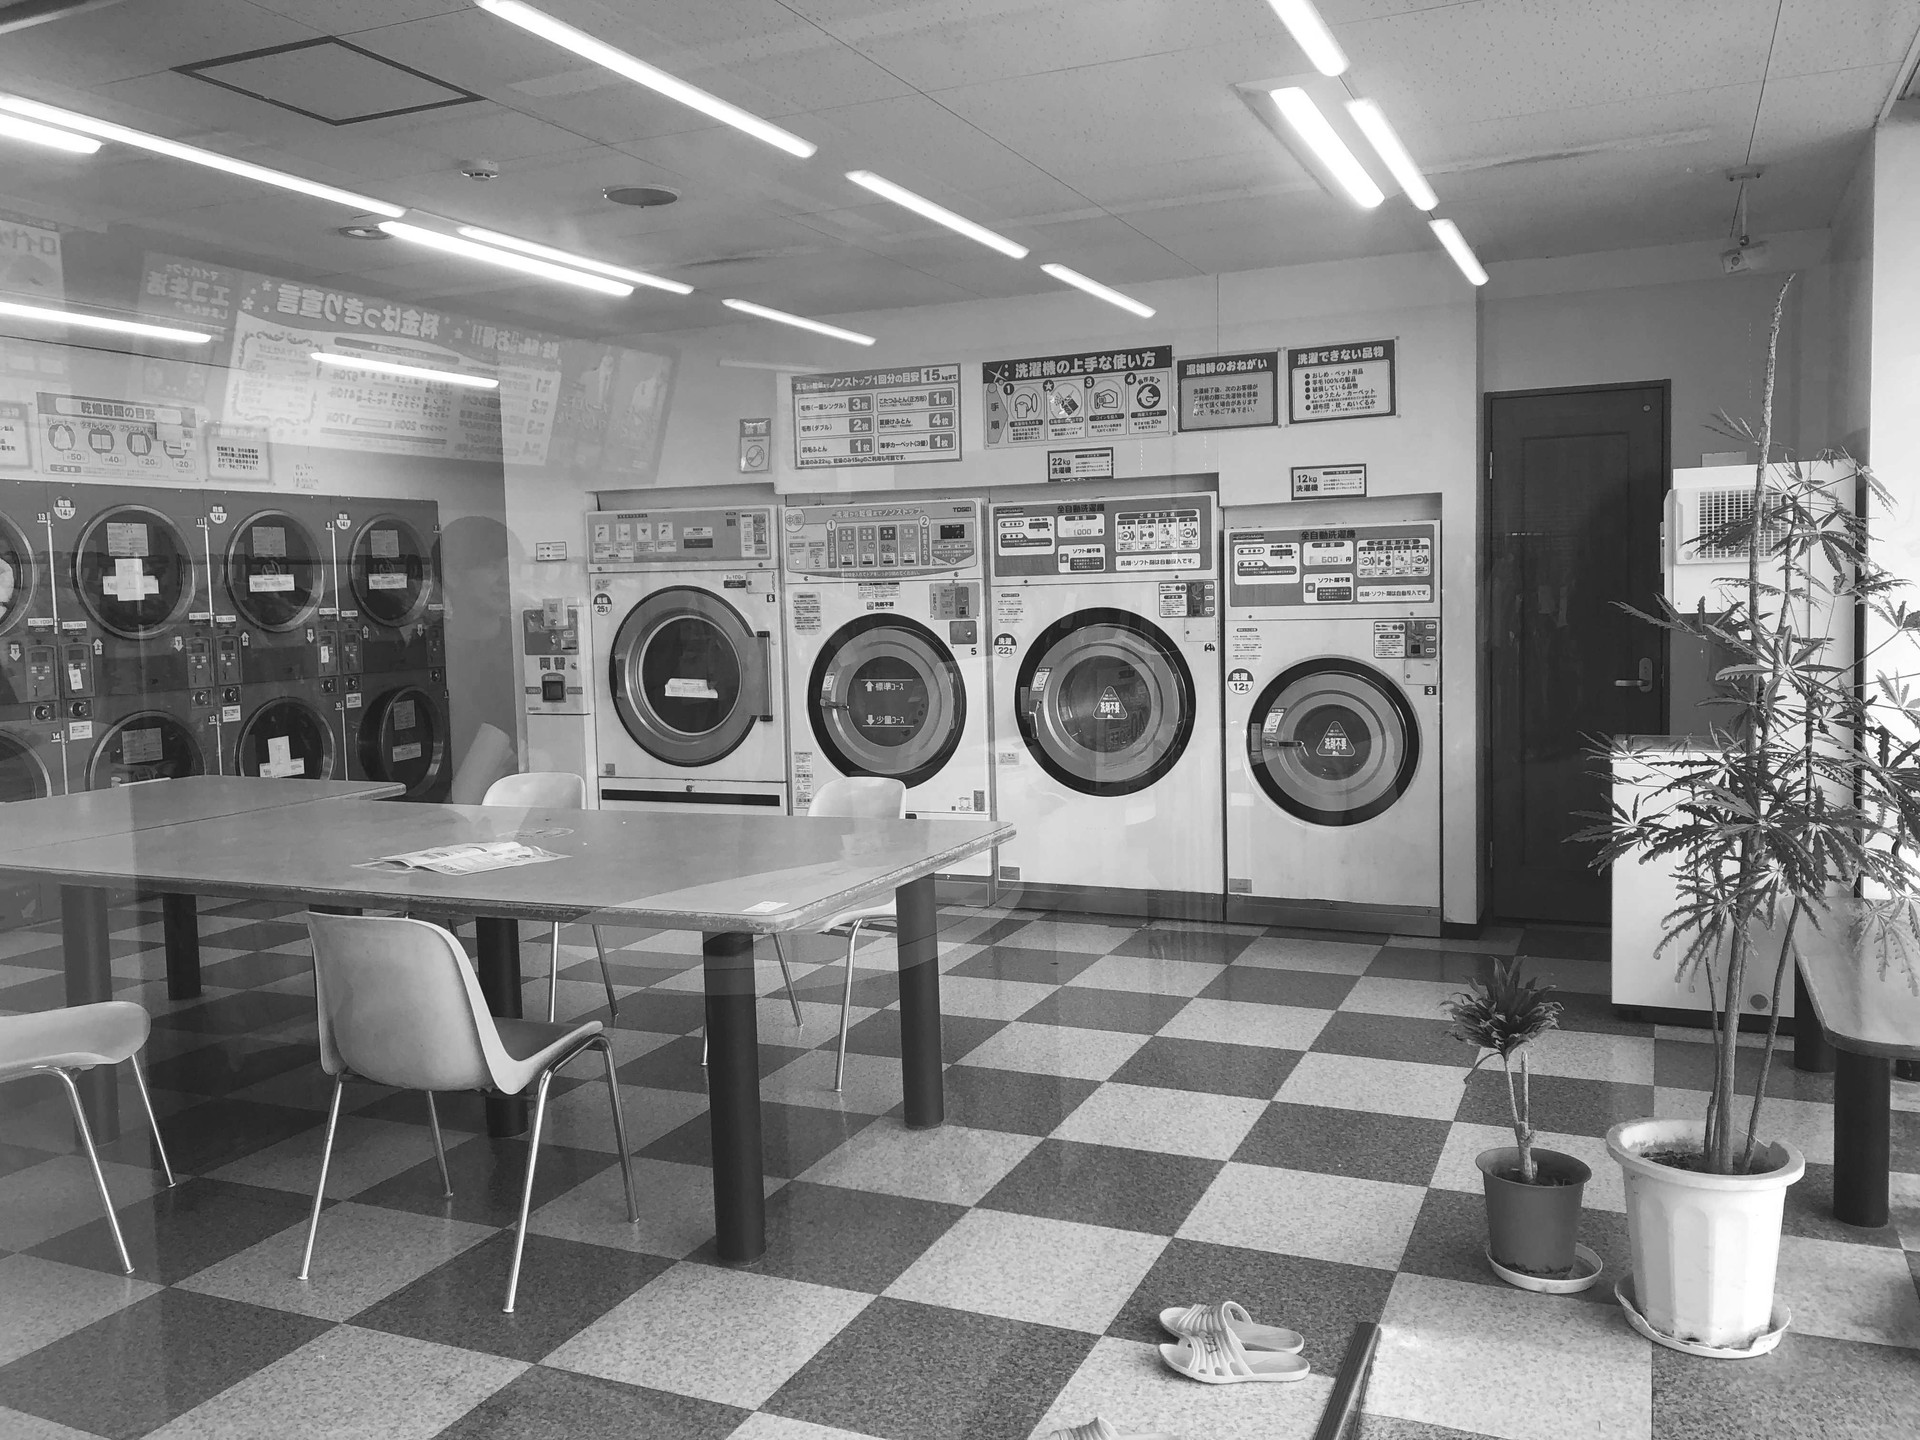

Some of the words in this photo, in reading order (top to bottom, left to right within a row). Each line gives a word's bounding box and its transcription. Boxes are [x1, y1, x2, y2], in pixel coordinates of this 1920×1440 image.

[1297, 346, 1385, 366] 洗濯できない品物
[1014, 351, 1157, 379] 洗濯機の上手な使い方
[1186, 358, 1268, 376] 混雑時のおねがい
[1052, 457, 1071, 466] 22kg
[1297, 474, 1318, 484] 12kg
[1057, 504, 1105, 515] 全自動洗濯機
[1301, 530, 1356, 541] 全自動洗濯機
[970, 647, 977, 655] 5
